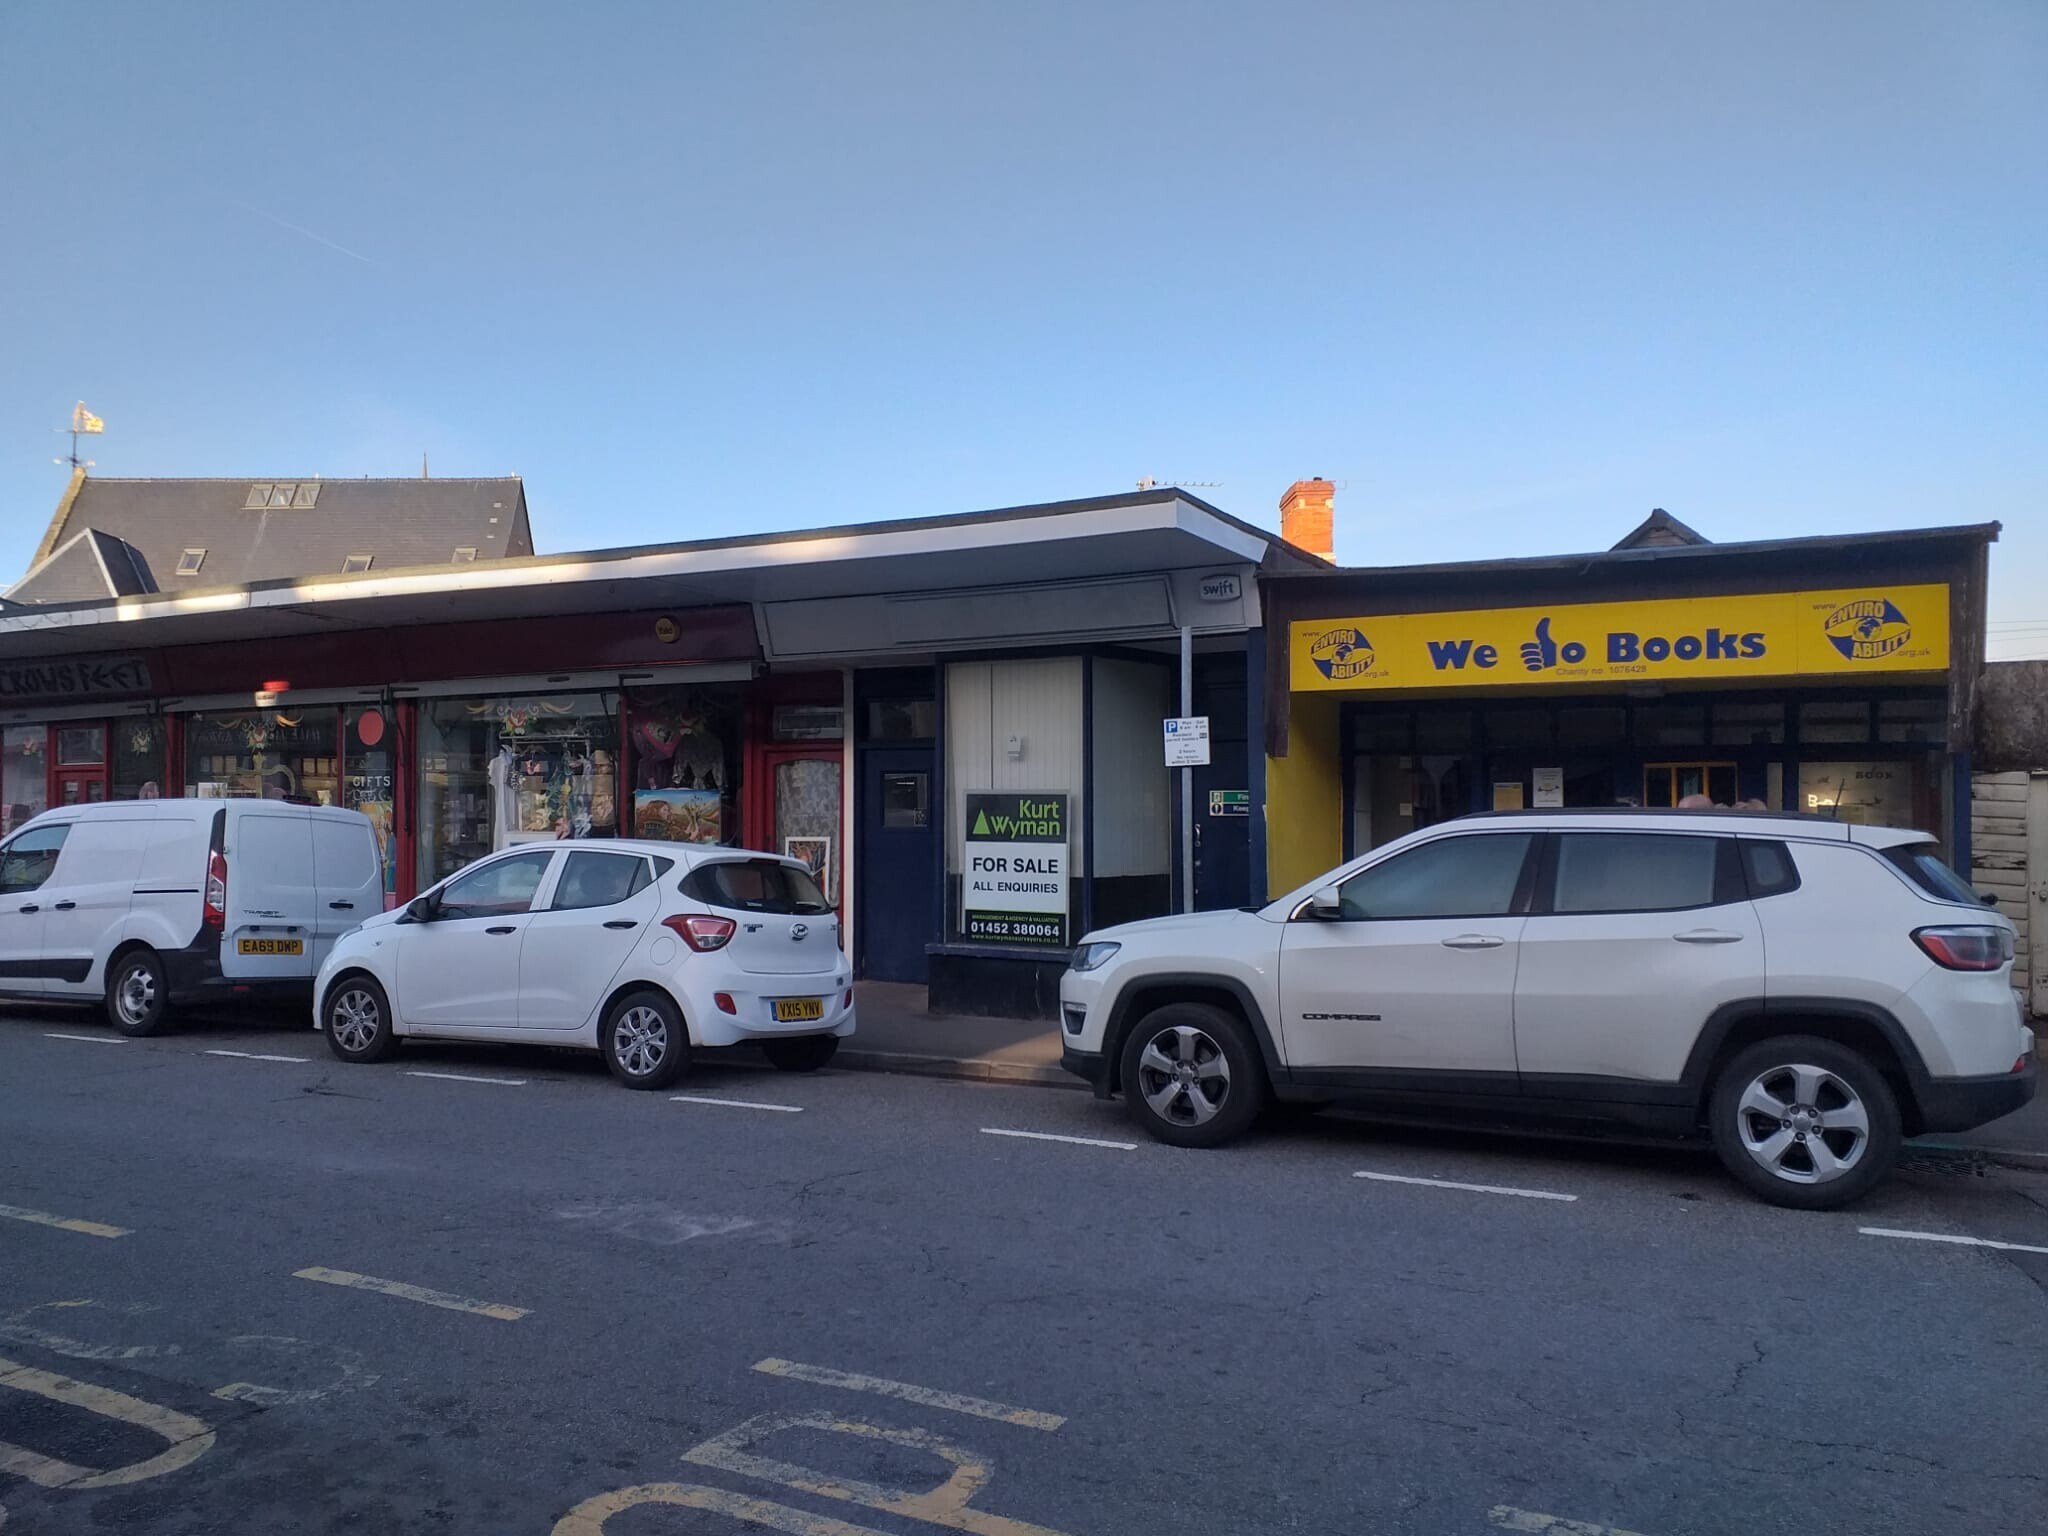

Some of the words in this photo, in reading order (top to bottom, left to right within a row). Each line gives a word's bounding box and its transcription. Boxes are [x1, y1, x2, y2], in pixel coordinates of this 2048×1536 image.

[1203, 580, 1233, 597] swift
[1828, 601, 1885, 628] ENVIRO
[1312, 629, 1357, 653] ENVIRO
[1426, 639, 1498, 670] We
[1607, 628, 1767, 663] Books
[1852, 631, 1909, 658] ABILITY
[1331, 655, 1374, 679] ABILITY
[352, 775, 391, 787] GIFTS
[1019, 799, 1060, 819] Kurt
[990, 815, 1060, 839] Wyman
[973, 857, 1007, 872] FOR
[1013, 858, 1058, 874] SALE
[973, 881, 993, 891] ALL
[997, 881, 1058, 893] ENQUIRIES
[971, 921, 1009, 934] 01452
[1013, 924, 1059, 937] 380064
[243, 940, 274, 952] EA69
[277, 941, 298, 953] DWP
[780, 1002, 801, 1018] VX15
